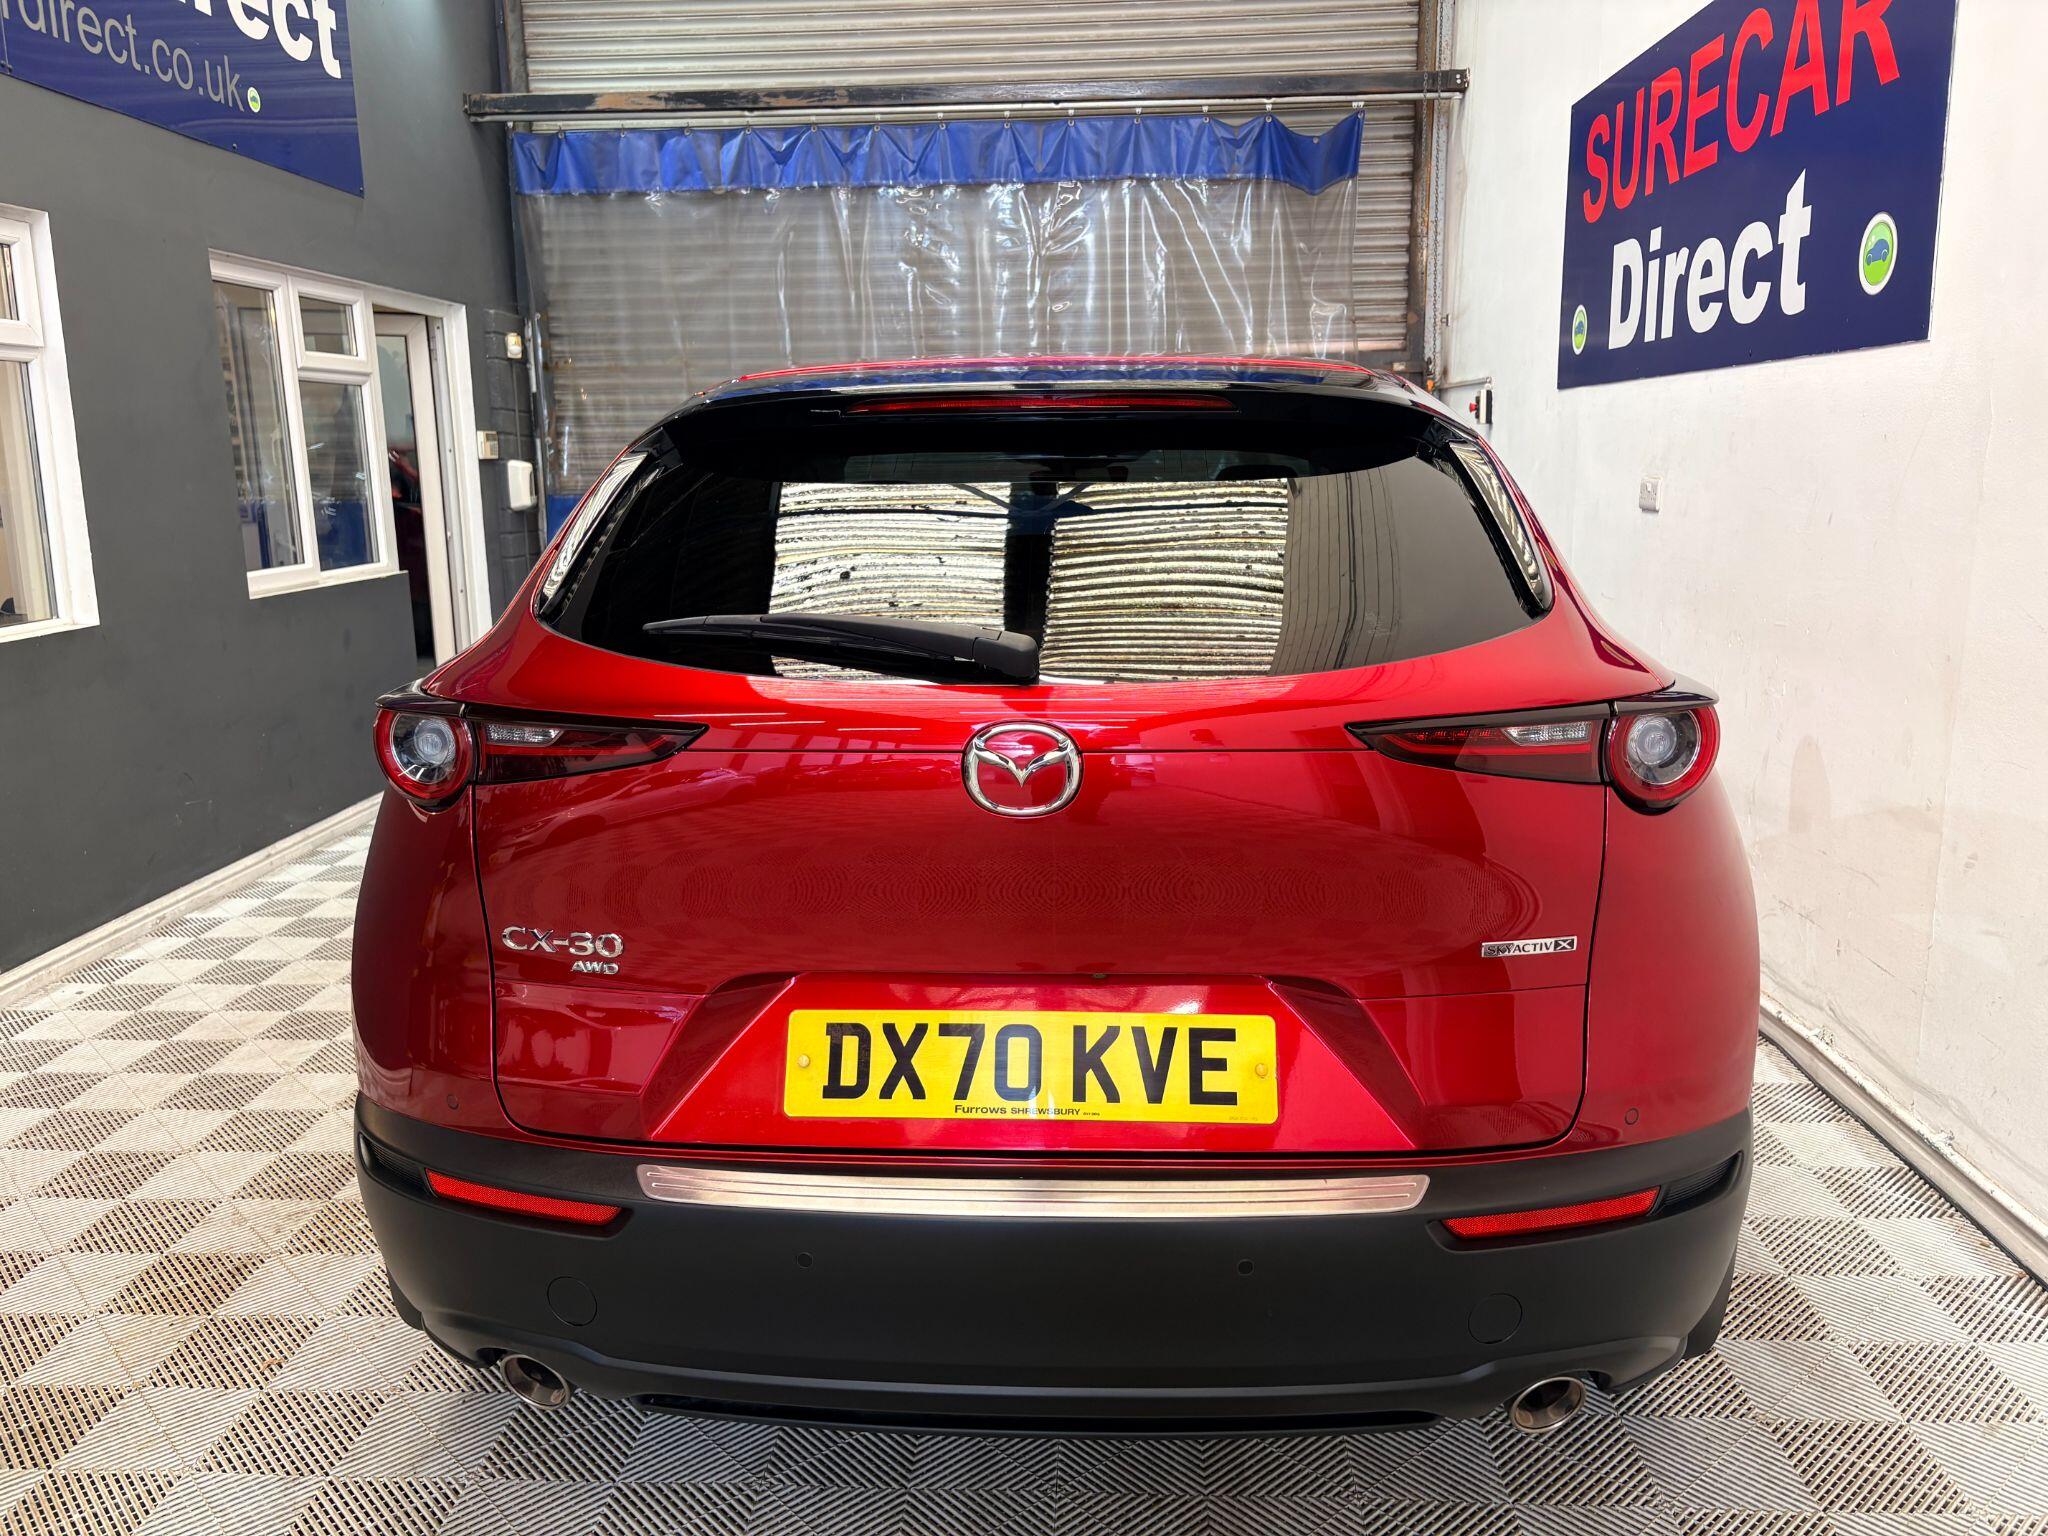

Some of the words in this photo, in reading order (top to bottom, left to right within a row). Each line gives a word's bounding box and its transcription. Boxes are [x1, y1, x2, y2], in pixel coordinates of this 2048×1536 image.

[1583, 0, 1900, 223] SURECAR
[1608, 168, 1812, 350] Direct
[502, 926, 624, 958] CX-30
[571, 960, 619, 974] AWD
[823, 1022, 1042, 1102] DX70
[1072, 1025, 1237, 1106] KVE
[954, 1104, 1007, 1115] Furrows
[1010, 1107, 1081, 1116] SHREWSBURY
